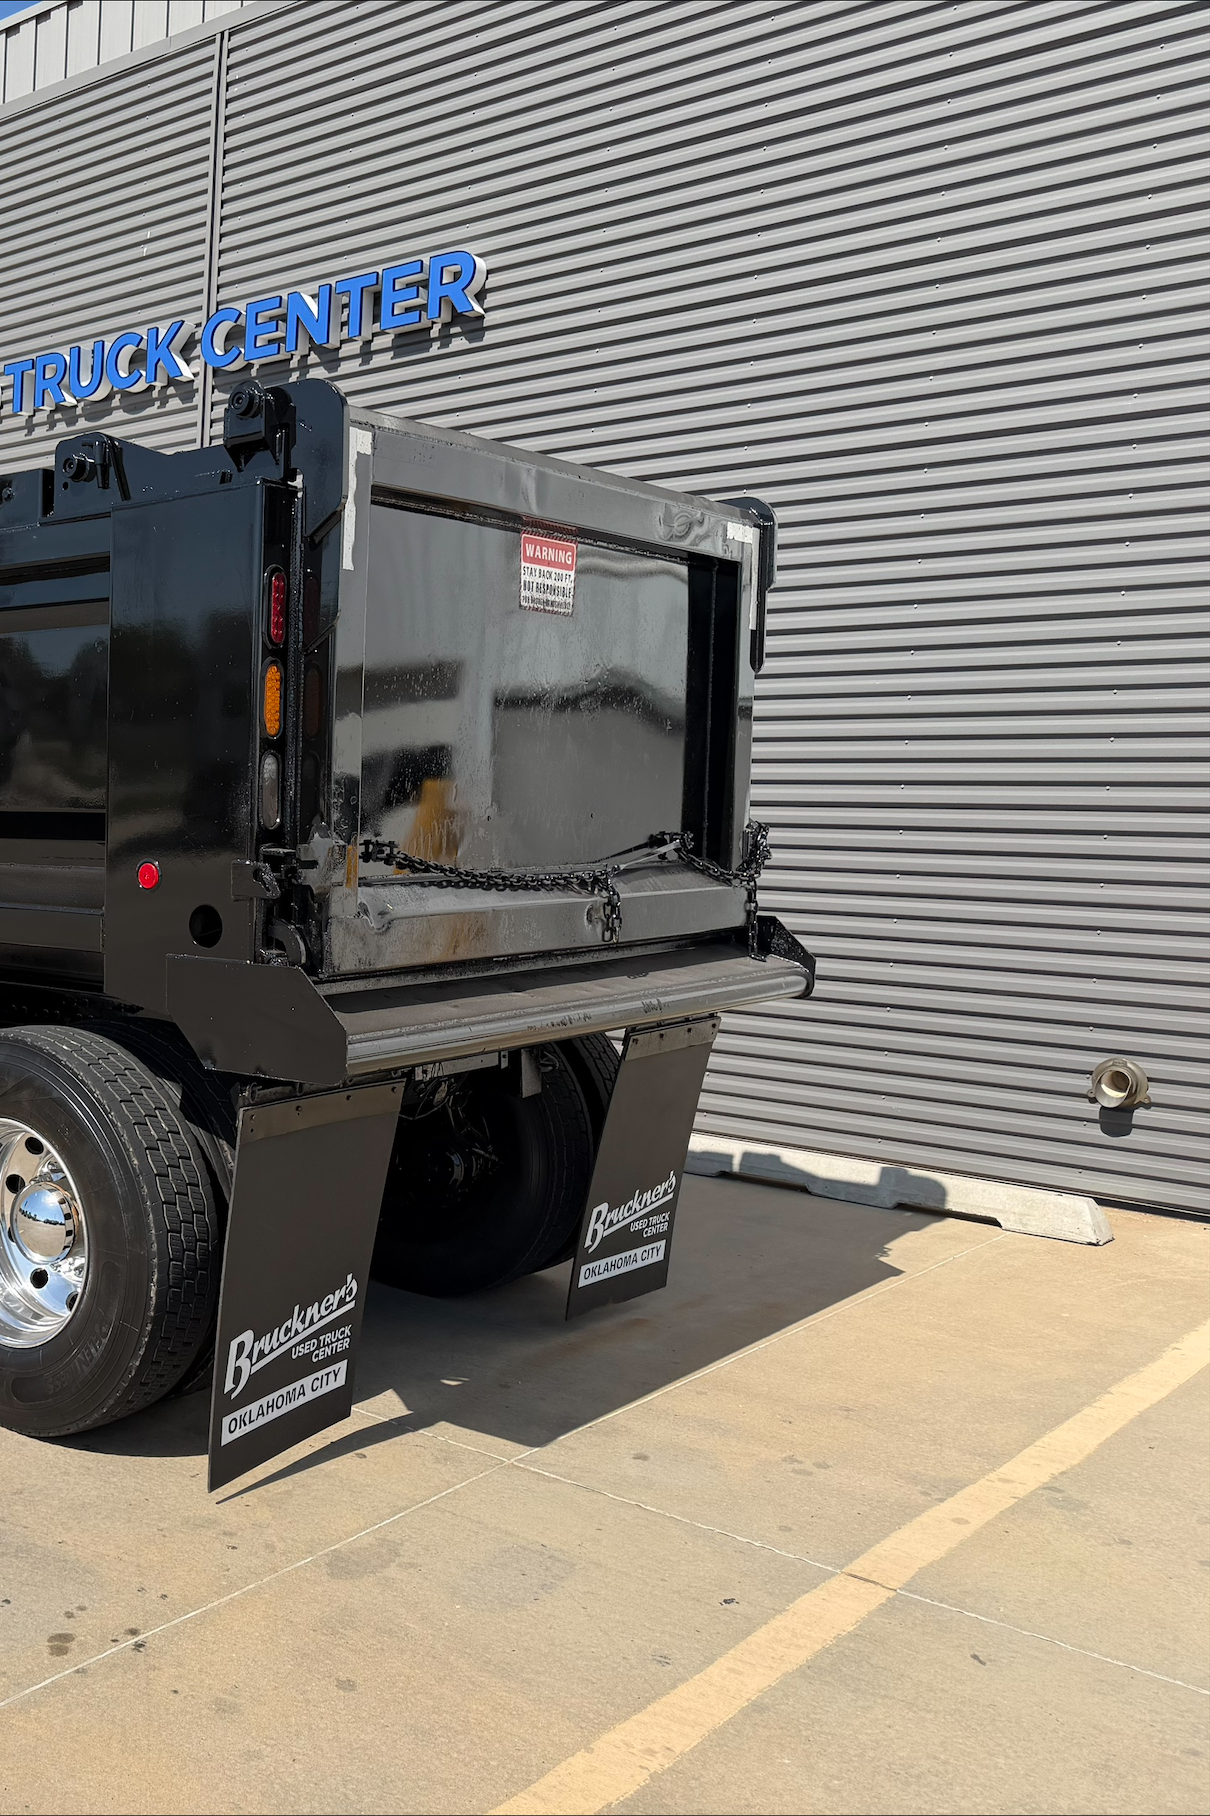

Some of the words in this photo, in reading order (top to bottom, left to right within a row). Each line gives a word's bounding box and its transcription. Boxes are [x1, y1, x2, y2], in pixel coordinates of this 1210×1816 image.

[3, 319, 195, 414] TRUCK
[200, 248, 486, 371] CENTER
[525, 543, 572, 564] WARNING
[523, 566, 537, 577] STAY
[538, 568, 553, 581] BACK
[554, 572, 564, 582] 200
[523, 579, 534, 592] NOT
[535, 582, 572, 598] RESPONSIBLE
[584, 1170, 676, 1254] Bruckner's
[630, 1220, 648, 1232] USED
[649, 1211, 671, 1226] TRUCK
[643, 1222, 668, 1238] CENTER
[583, 1252, 638, 1280] OKLAHOMA
[640, 1244, 662, 1262] CITY
[224, 1273, 358, 1400] Bruckner's
[291, 1338, 318, 1359] USED
[319, 1324, 352, 1345] TRUCK
[311, 1337, 350, 1363] CENTER
[228, 1383, 306, 1434] OKLAHOMA
[310, 1366, 341, 1392] CITY
